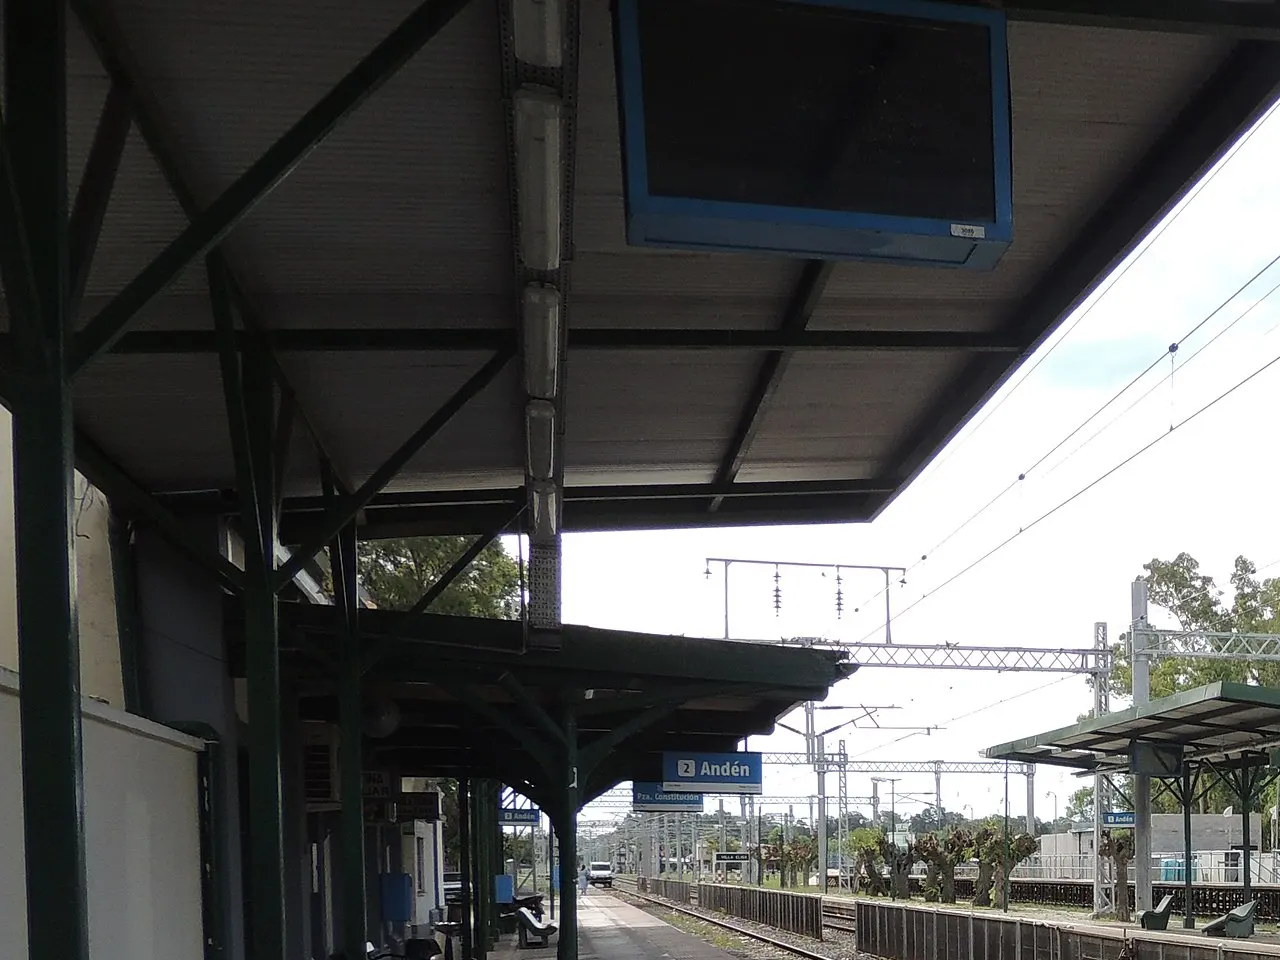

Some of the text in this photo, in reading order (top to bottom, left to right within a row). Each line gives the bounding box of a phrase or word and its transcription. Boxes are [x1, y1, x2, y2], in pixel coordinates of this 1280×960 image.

[700, 760, 750, 777] Andén
[654, 792, 699, 801] Constitución
[514, 812, 535, 820] Andén
